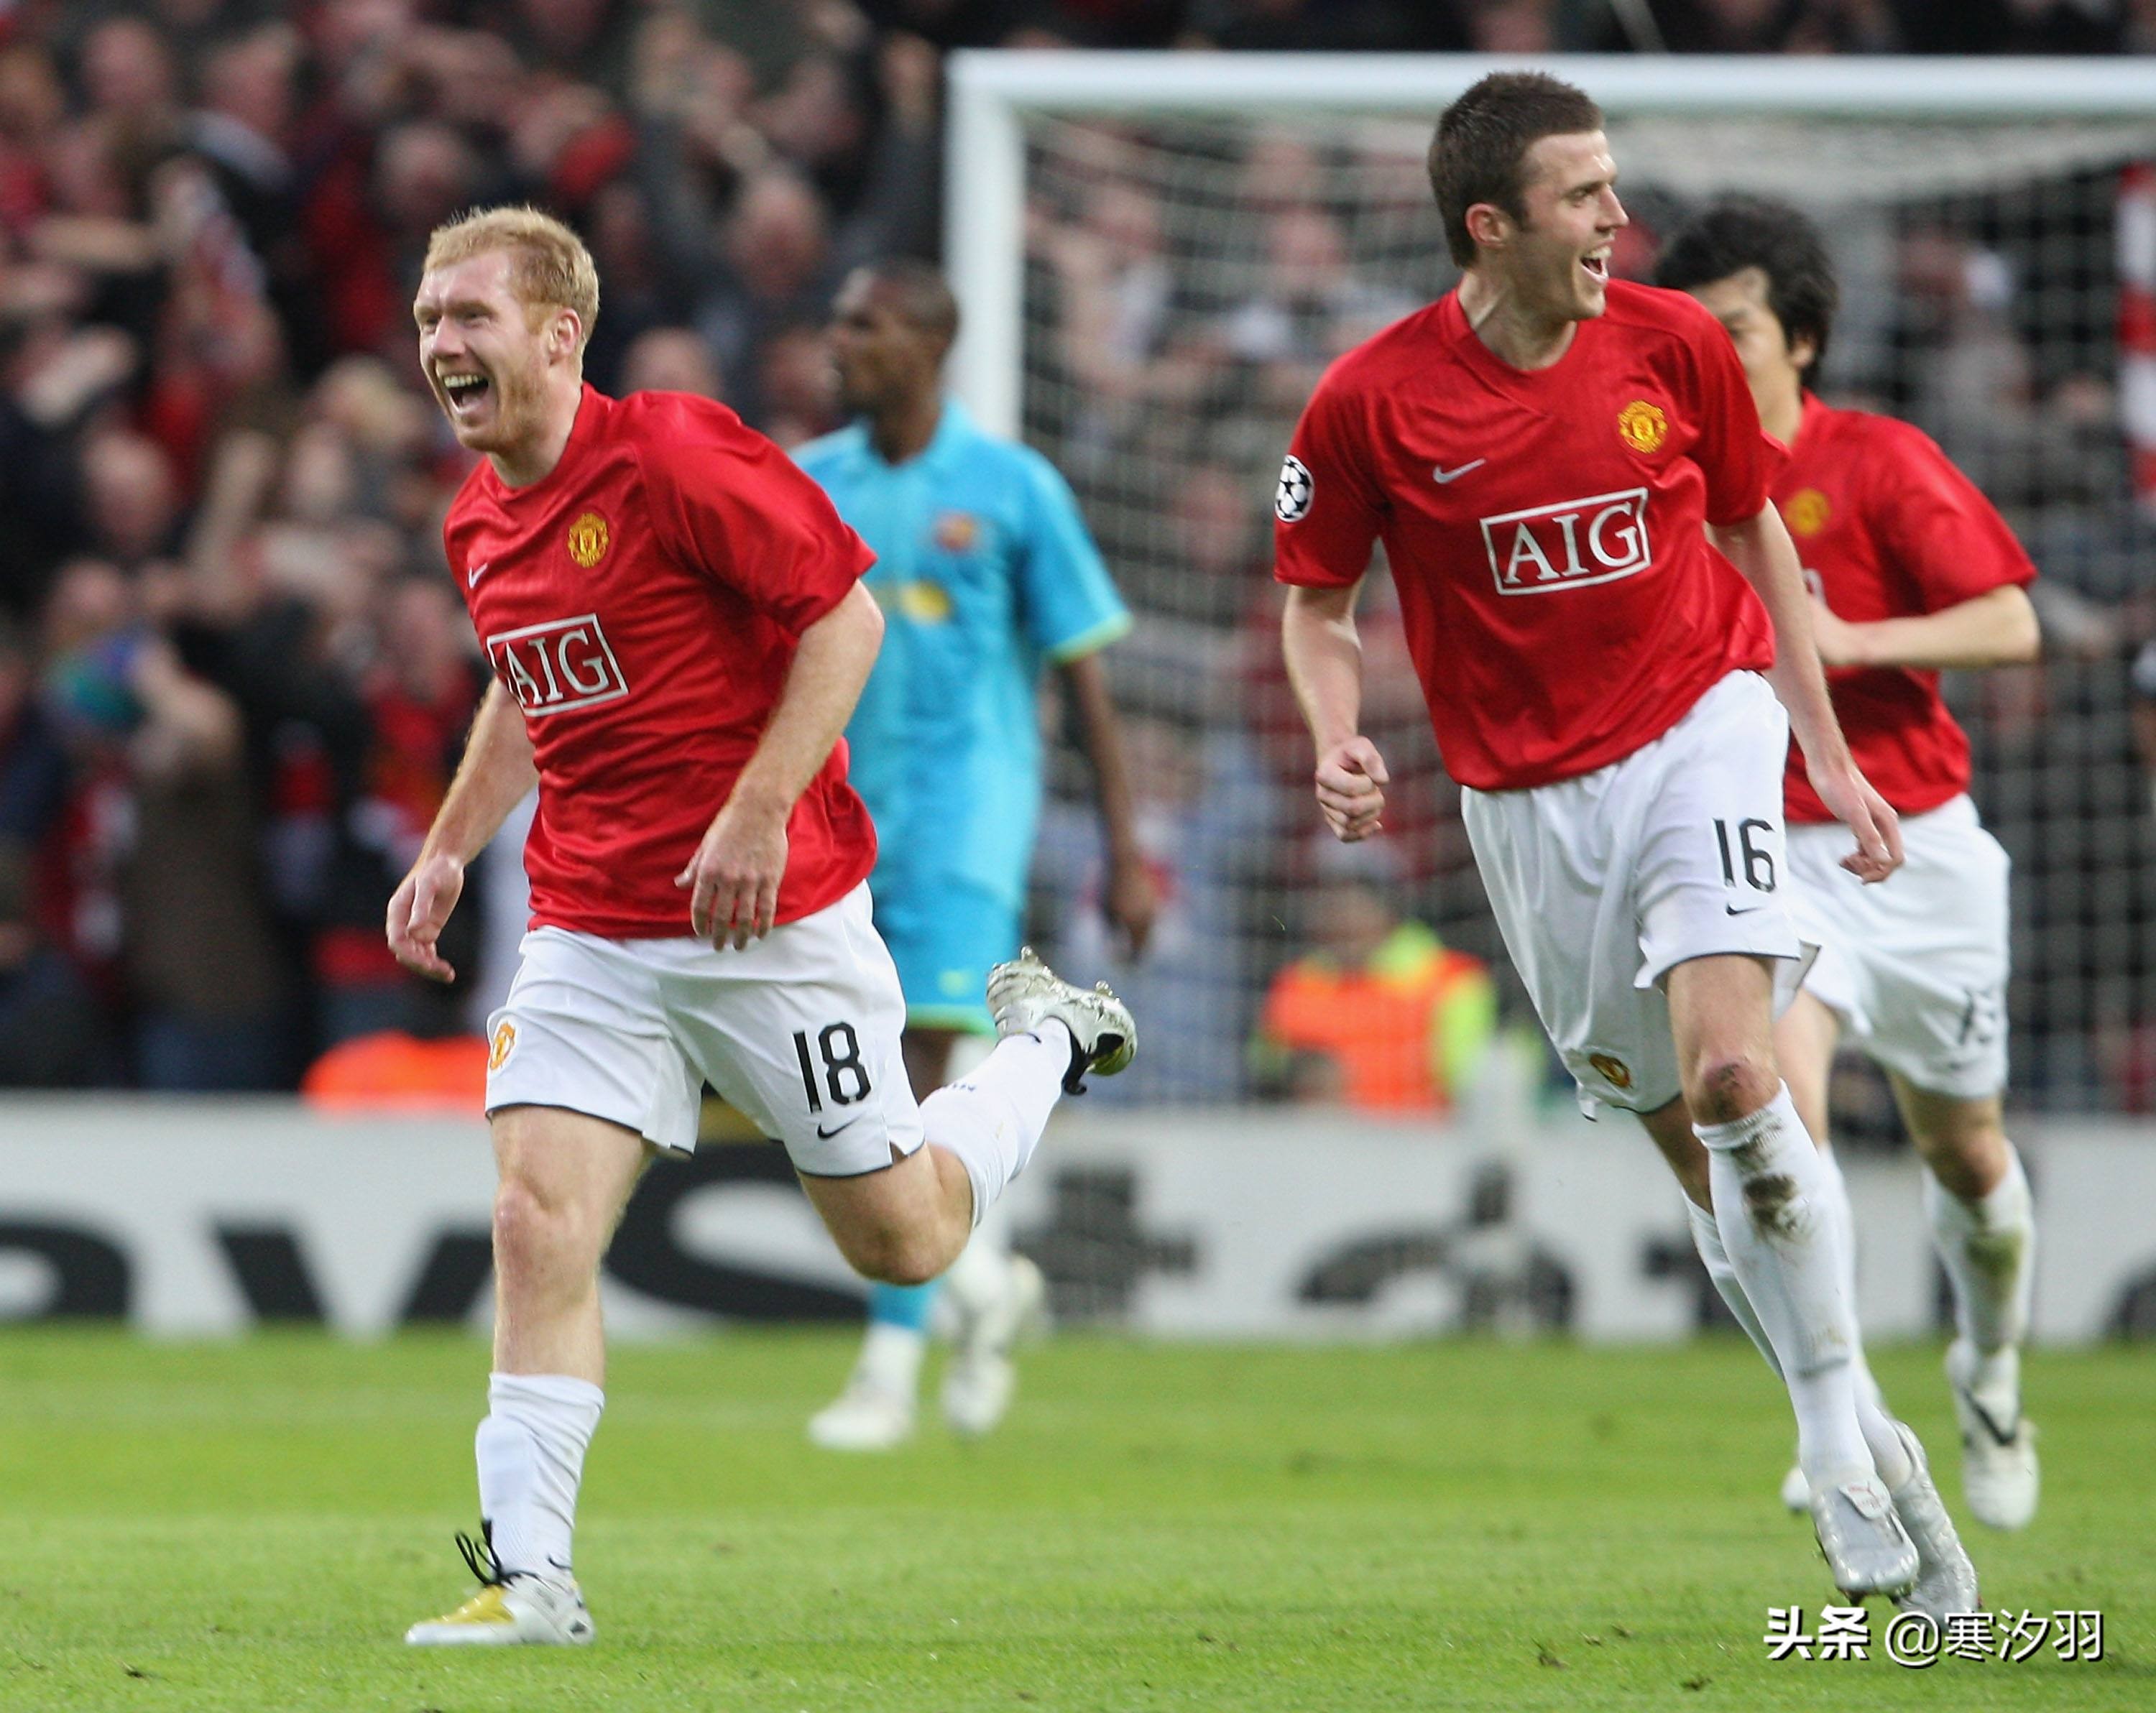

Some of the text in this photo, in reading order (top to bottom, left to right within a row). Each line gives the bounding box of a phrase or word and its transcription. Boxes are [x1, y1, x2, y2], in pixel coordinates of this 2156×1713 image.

[1503, 502, 1639, 584] AIG
[506, 629, 609, 705] AIG
[1713, 817, 1776, 893] 16
[793, 1022, 872, 1114] 18
